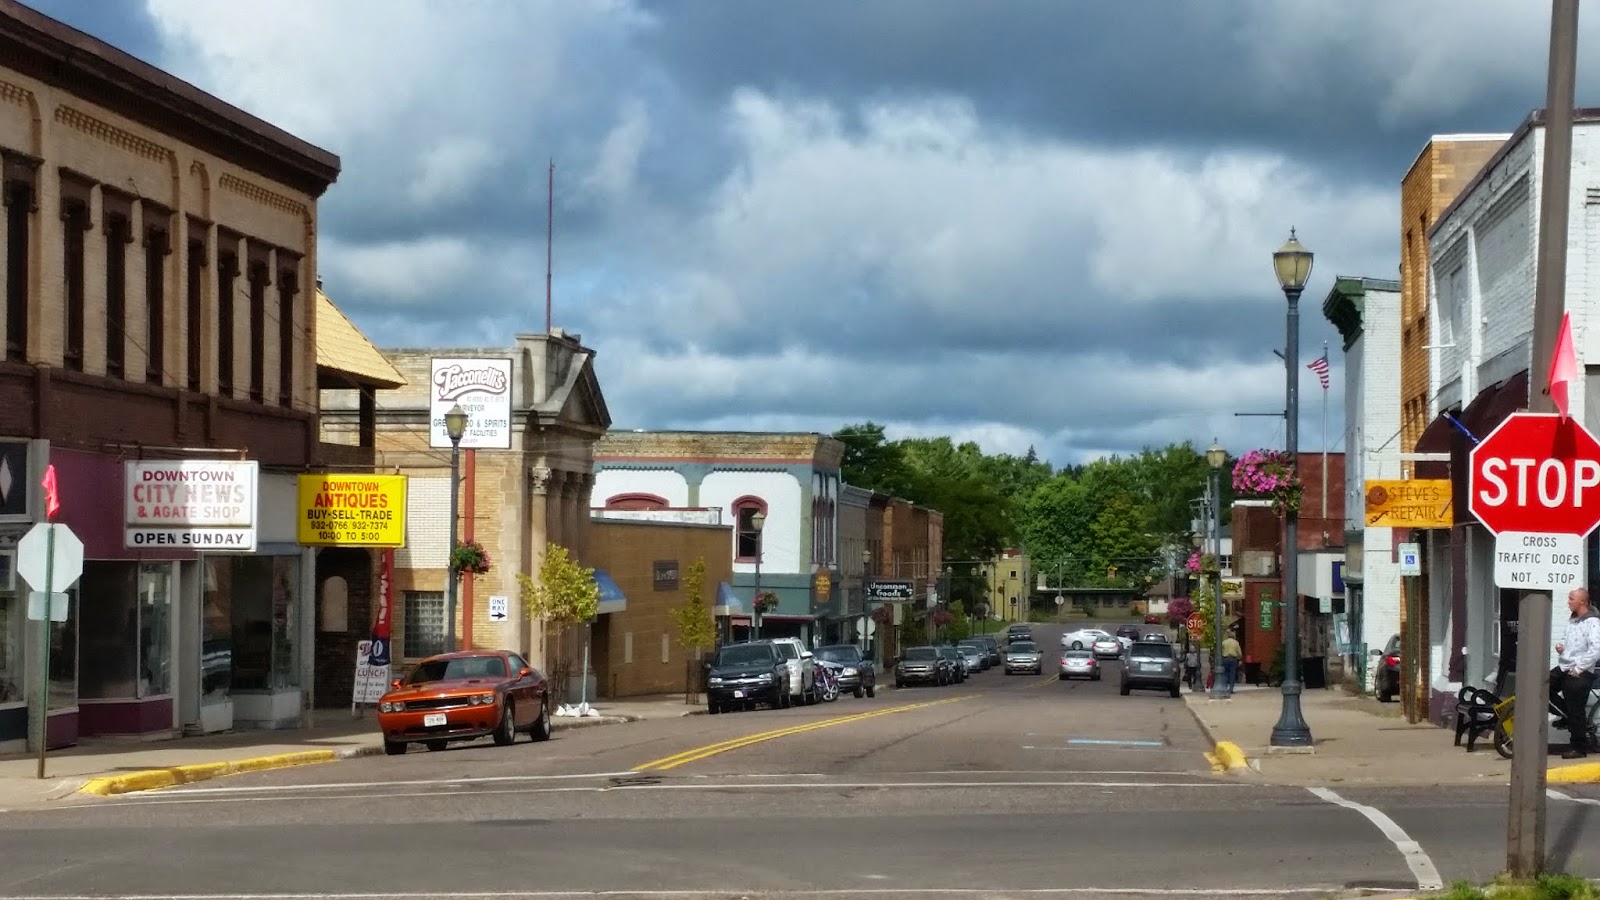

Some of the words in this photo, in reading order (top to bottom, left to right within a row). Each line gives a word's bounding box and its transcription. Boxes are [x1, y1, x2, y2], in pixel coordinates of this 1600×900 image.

[433, 364, 507, 400] Tacconelli's
[484, 419, 507, 428] SPIRITS
[470, 429, 498, 437] FACILITIES
[142, 470, 235, 481] DOWNTOWN
[322, 481, 379, 492] DOWNTOWN
[1479, 457, 1600, 508] STOP
[133, 484, 178, 503] CITY
[184, 484, 245, 503] NEWS
[1389, 486, 1439, 501] STEVE'S
[314, 493, 388, 508] ANTIQUES
[137, 506, 148, 518] &
[153, 506, 197, 518] AGATE
[203, 506, 241, 518] SHOP
[307, 509, 393, 520] BUY-SELL-TRADE
[1390, 505, 1437, 520] REPAIR
[134, 533, 176, 544] OPEN
[182, 533, 245, 544] SUNDAY
[319, 532, 342, 540] 10:00
[346, 532, 357, 540] TO
[360, 532, 380, 540] 5:00
[1522, 536, 1557, 548] CROSS
[1498, 552, 1541, 564] TRAFFIC
[1552, 554, 1580, 565] DOES
[1511, 572, 1532, 583] NOT
[1548, 573, 1575, 584] STOP
[870, 582, 907, 590] Uncommon
[876, 589, 901, 597] Goods
[357, 668, 386, 677] LUNCH
